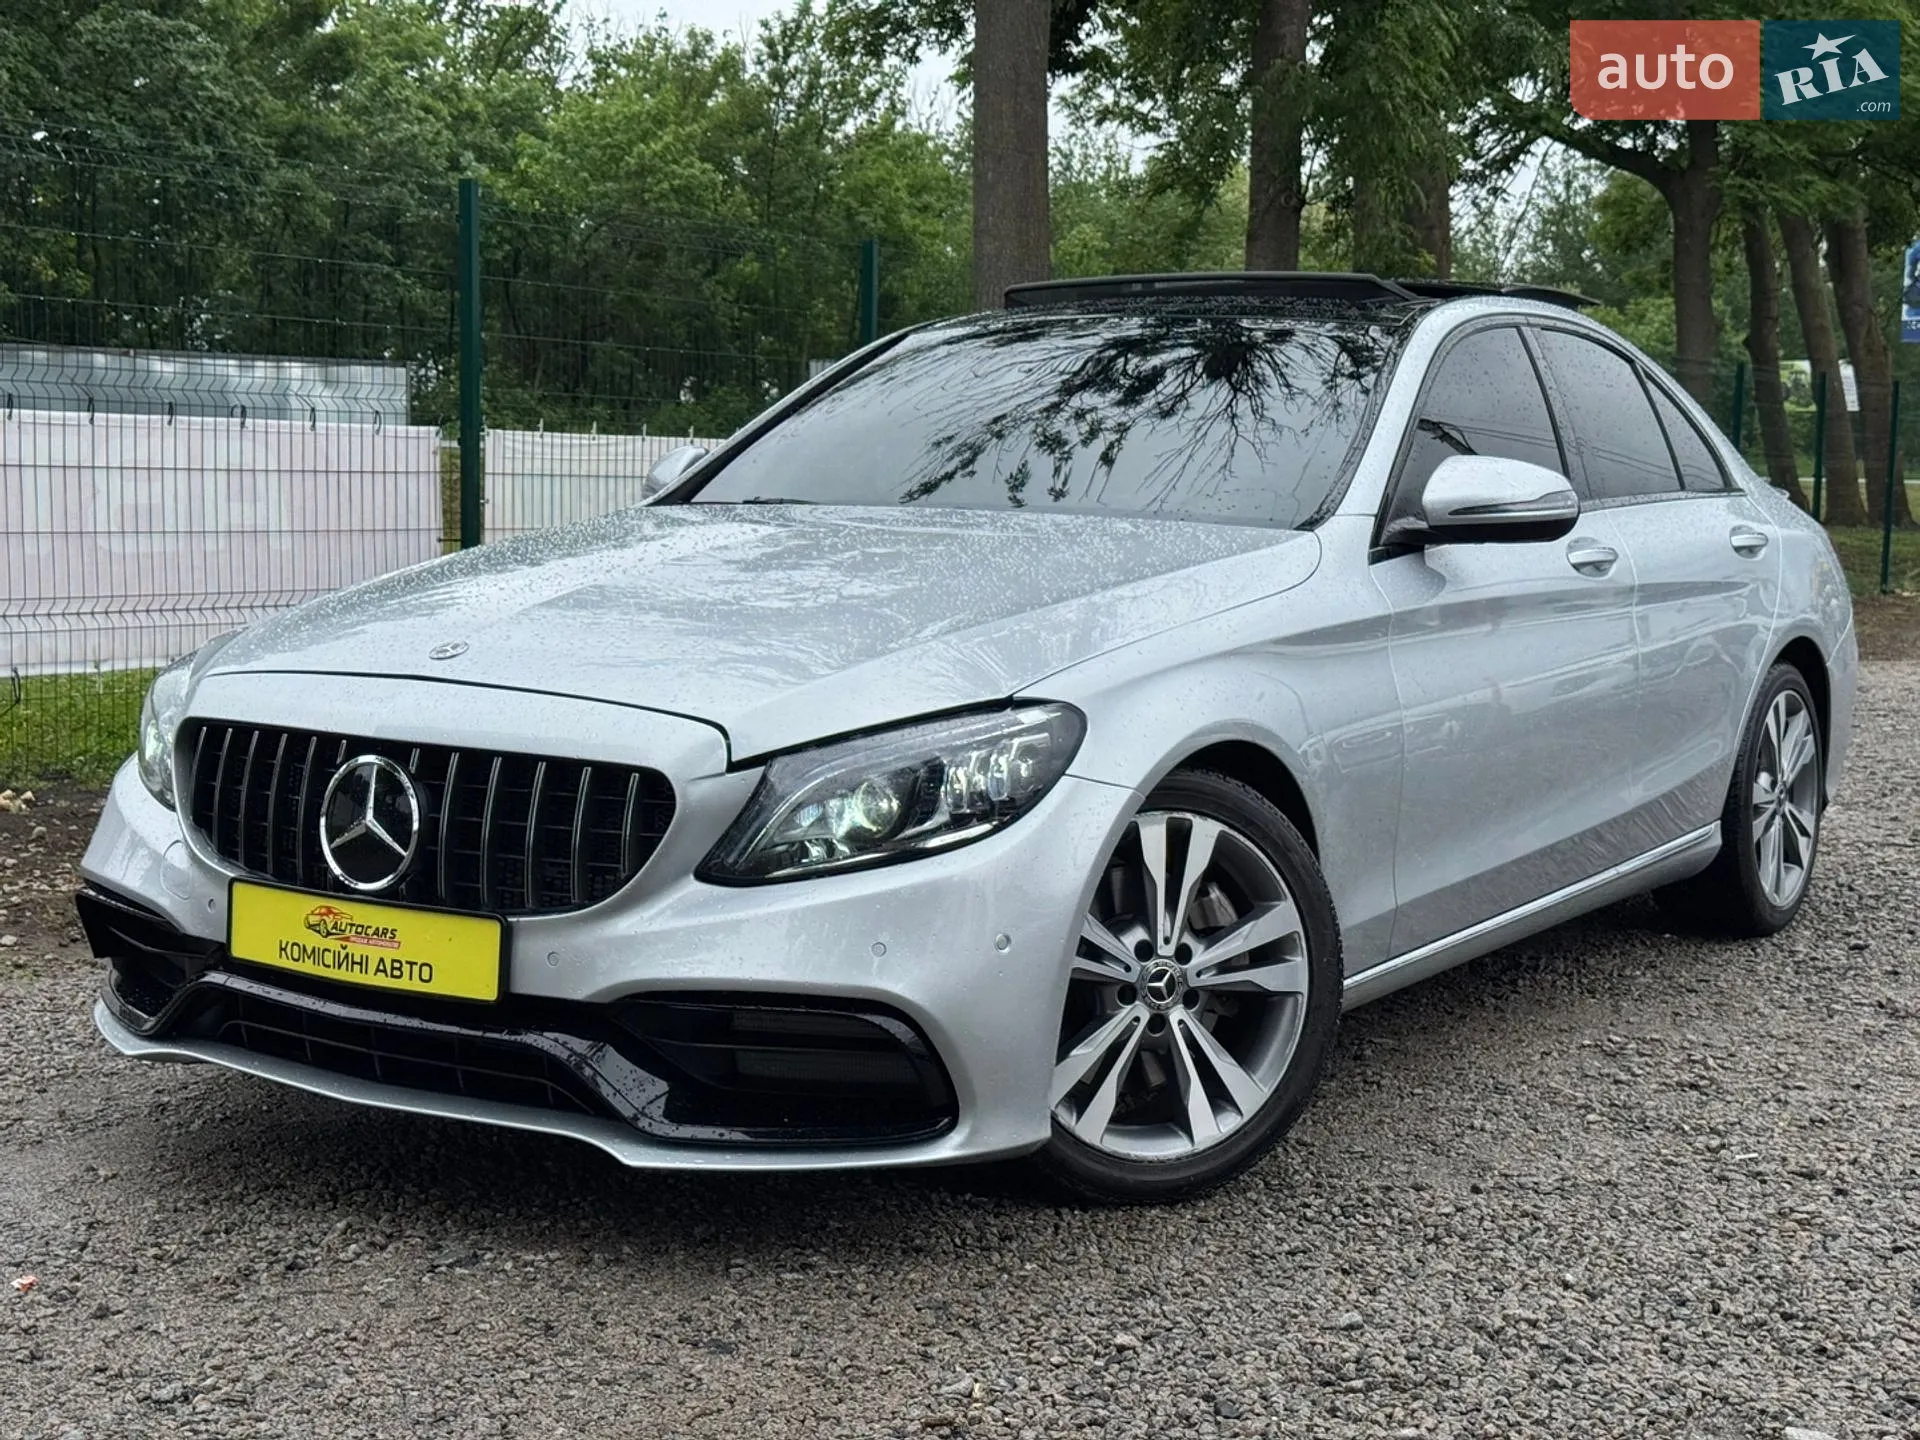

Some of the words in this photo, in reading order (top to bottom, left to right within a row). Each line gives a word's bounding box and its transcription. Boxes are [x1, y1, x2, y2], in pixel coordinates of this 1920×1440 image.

[330, 921, 398, 940] AUTOCARS
[278, 939, 369, 975] КОМІСІЙНІ
[374, 956, 434, 984] АВТО
